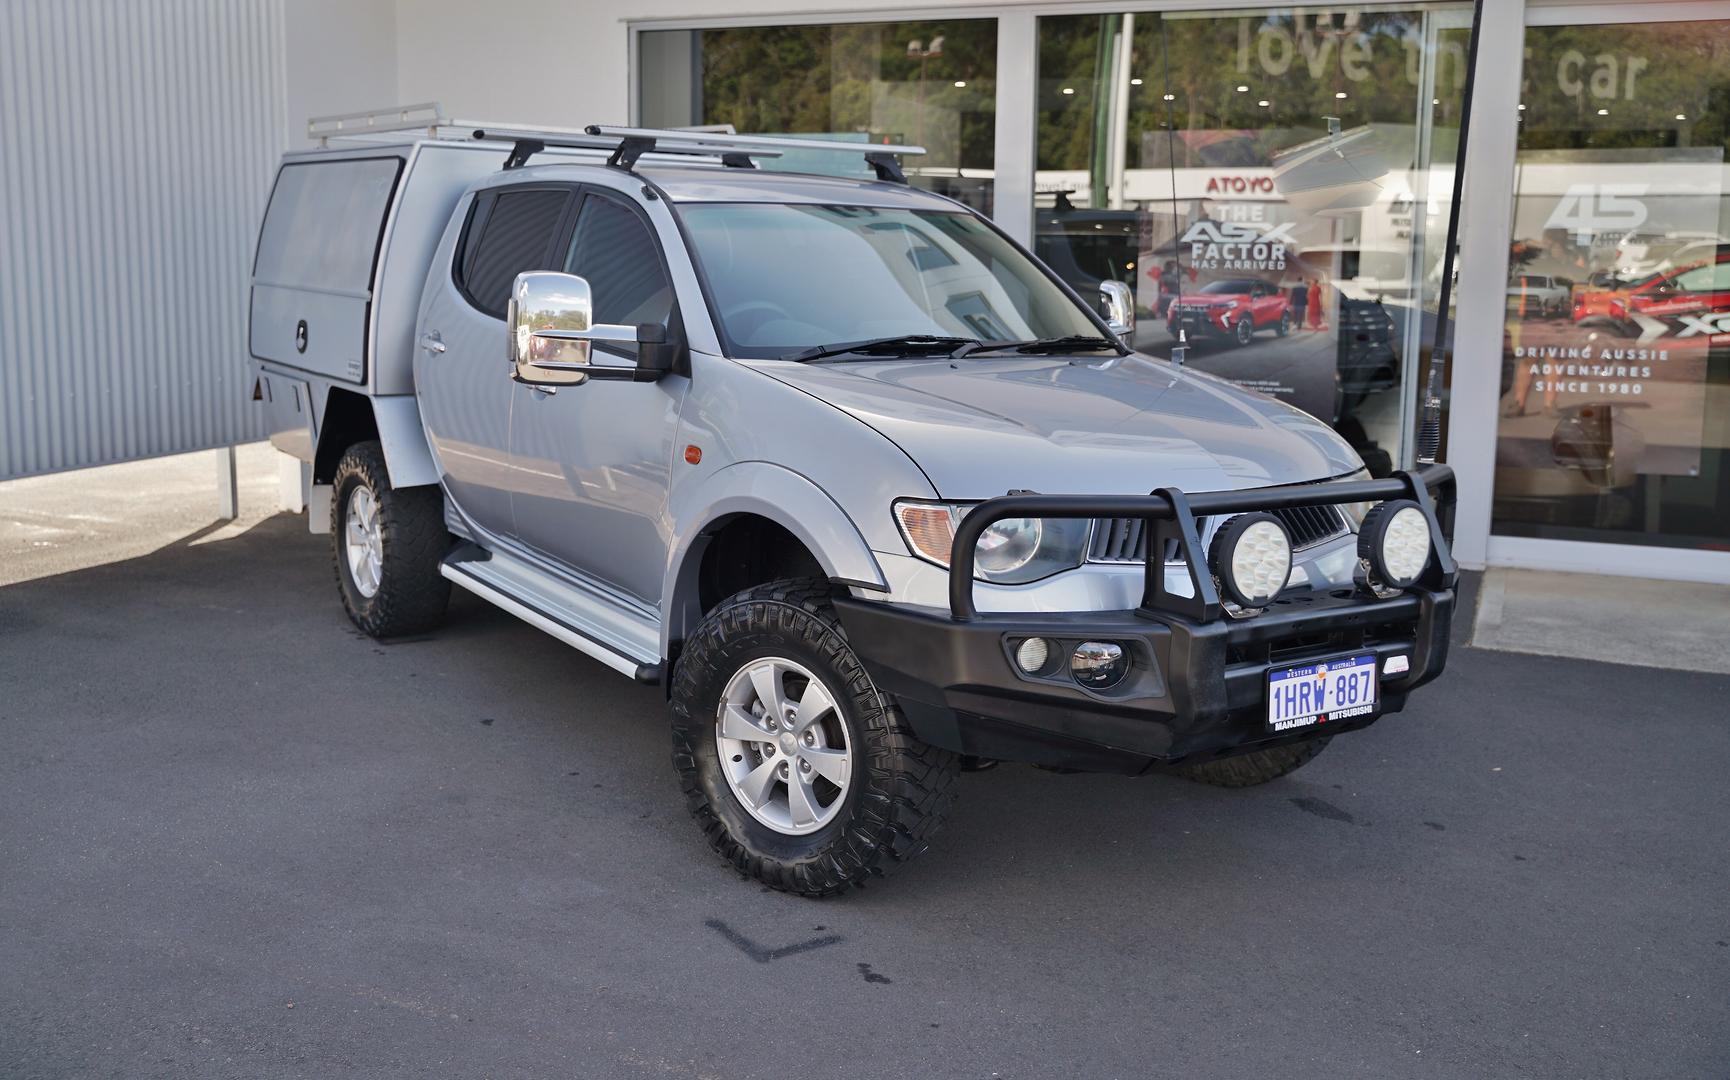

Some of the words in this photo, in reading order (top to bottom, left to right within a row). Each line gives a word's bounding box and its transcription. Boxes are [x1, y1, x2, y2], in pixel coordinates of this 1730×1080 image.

[1236, 17, 1373, 81] love
[1557, 50, 1649, 99] car
[1217, 205, 1265, 221] THE
[1544, 184, 1648, 245] 45
[1180, 222, 1297, 243] ASX
[1191, 242, 1286, 260] FACTOR
[1191, 260, 1218, 270] HAS
[1223, 260, 1286, 271] ARRIVED
[1515, 346, 1592, 359] DRIVING
[1600, 348, 1669, 361] AUSSIE
[1529, 363, 1652, 378] ADVENTURES
[1535, 380, 1590, 393] SINCE
[1598, 382, 1643, 395] 1980
[1286, 668, 1313, 678] WESTERN
[1331, 660, 1356, 670] AUSTRALIA
[1274, 715, 1317, 732] MANJIMUP
[1328, 704, 1373, 721] MITSUBISHI
